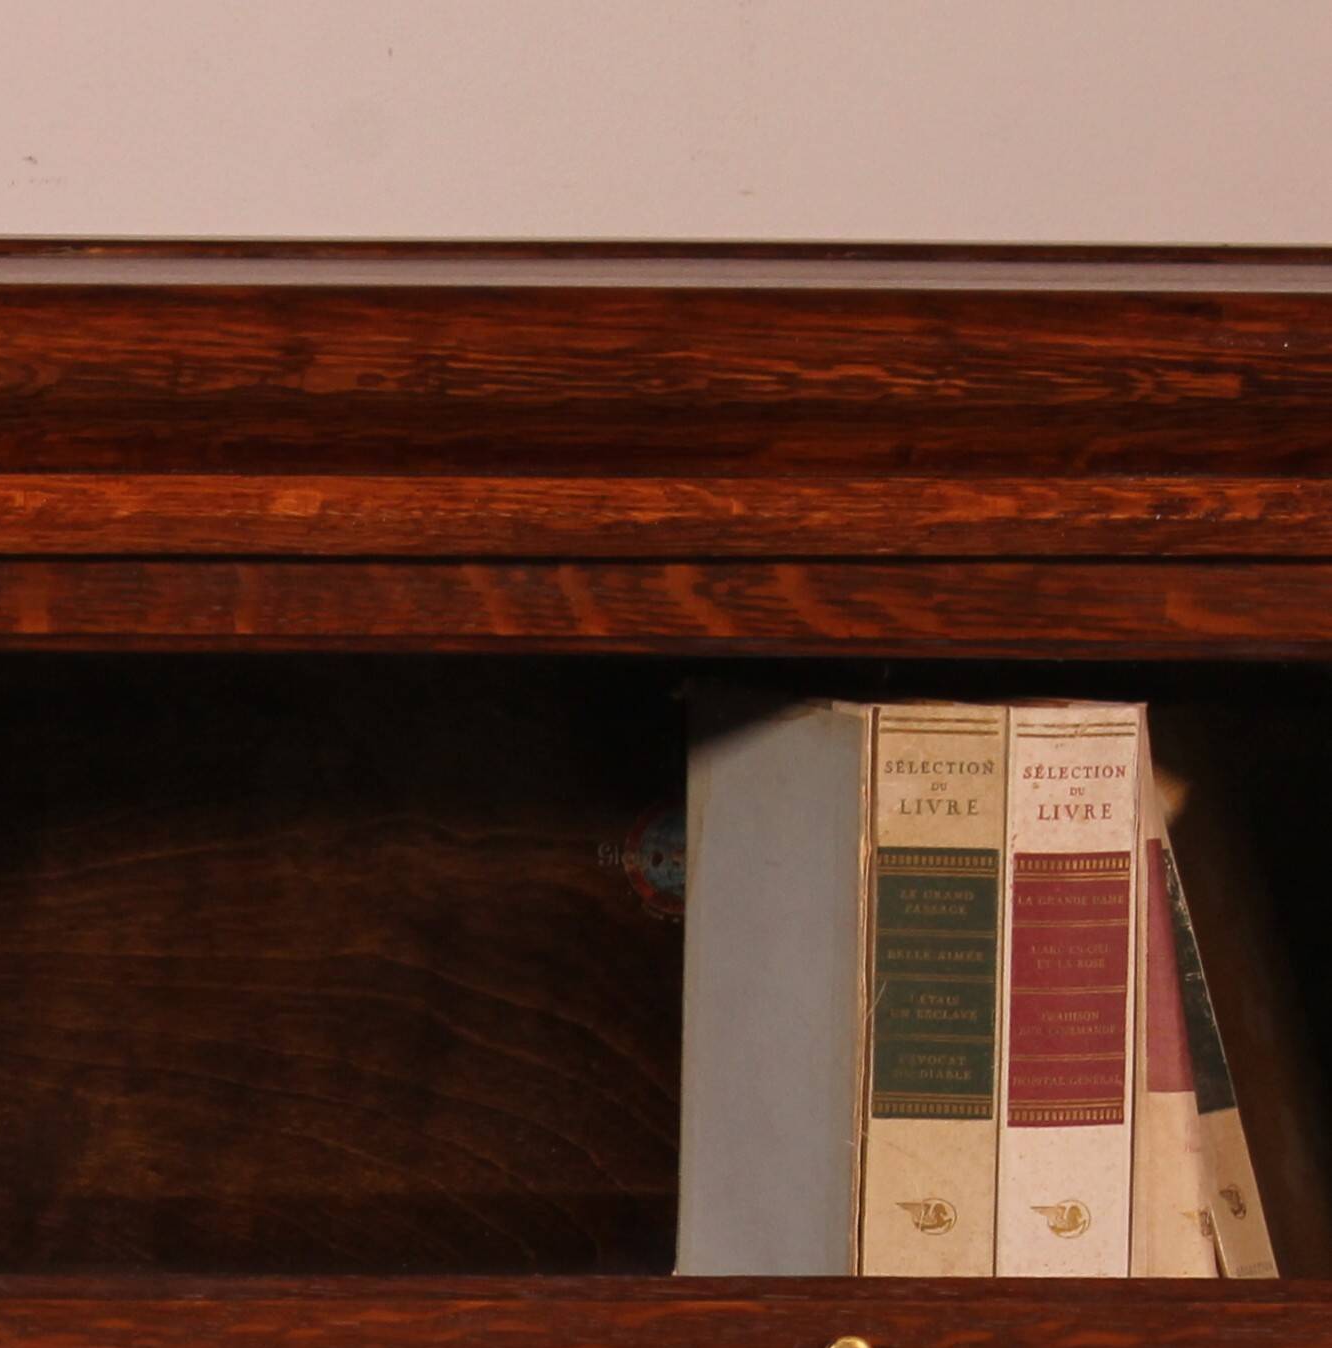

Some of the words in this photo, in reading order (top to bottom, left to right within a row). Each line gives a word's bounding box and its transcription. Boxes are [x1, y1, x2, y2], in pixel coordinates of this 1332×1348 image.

[884, 758, 996, 777] SÉLECTION
[1023, 762, 1127, 781] SÉLECTION
[931, 782, 948, 792] DU
[1070, 786, 1086, 797] DU
[900, 798, 980, 817] LIVRE
[1038, 803, 1113, 822] LIVRE
